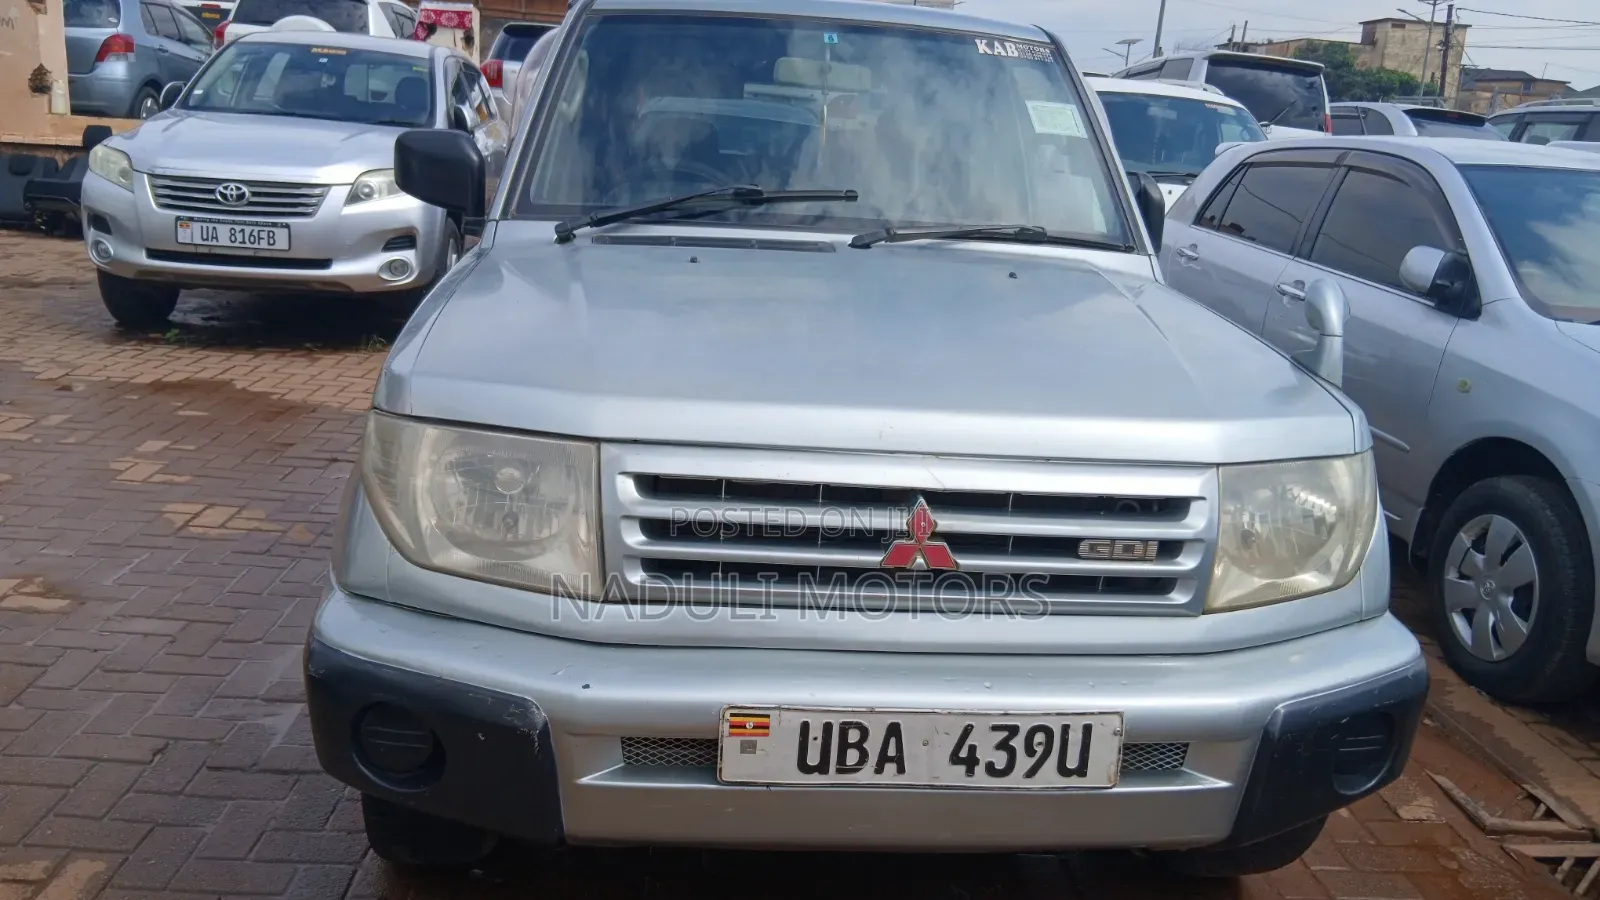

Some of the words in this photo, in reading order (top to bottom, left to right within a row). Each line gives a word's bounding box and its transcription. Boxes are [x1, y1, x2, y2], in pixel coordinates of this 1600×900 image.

[975, 39, 1018, 57] KAB
[1016, 43, 1050, 53] MOTORS
[200, 225, 219, 242] UA
[229, 227, 276, 247] 816FB
[1078, 539, 1159, 561] GDI
[796, 720, 907, 775] UBA
[948, 722, 1094, 779] 439U
